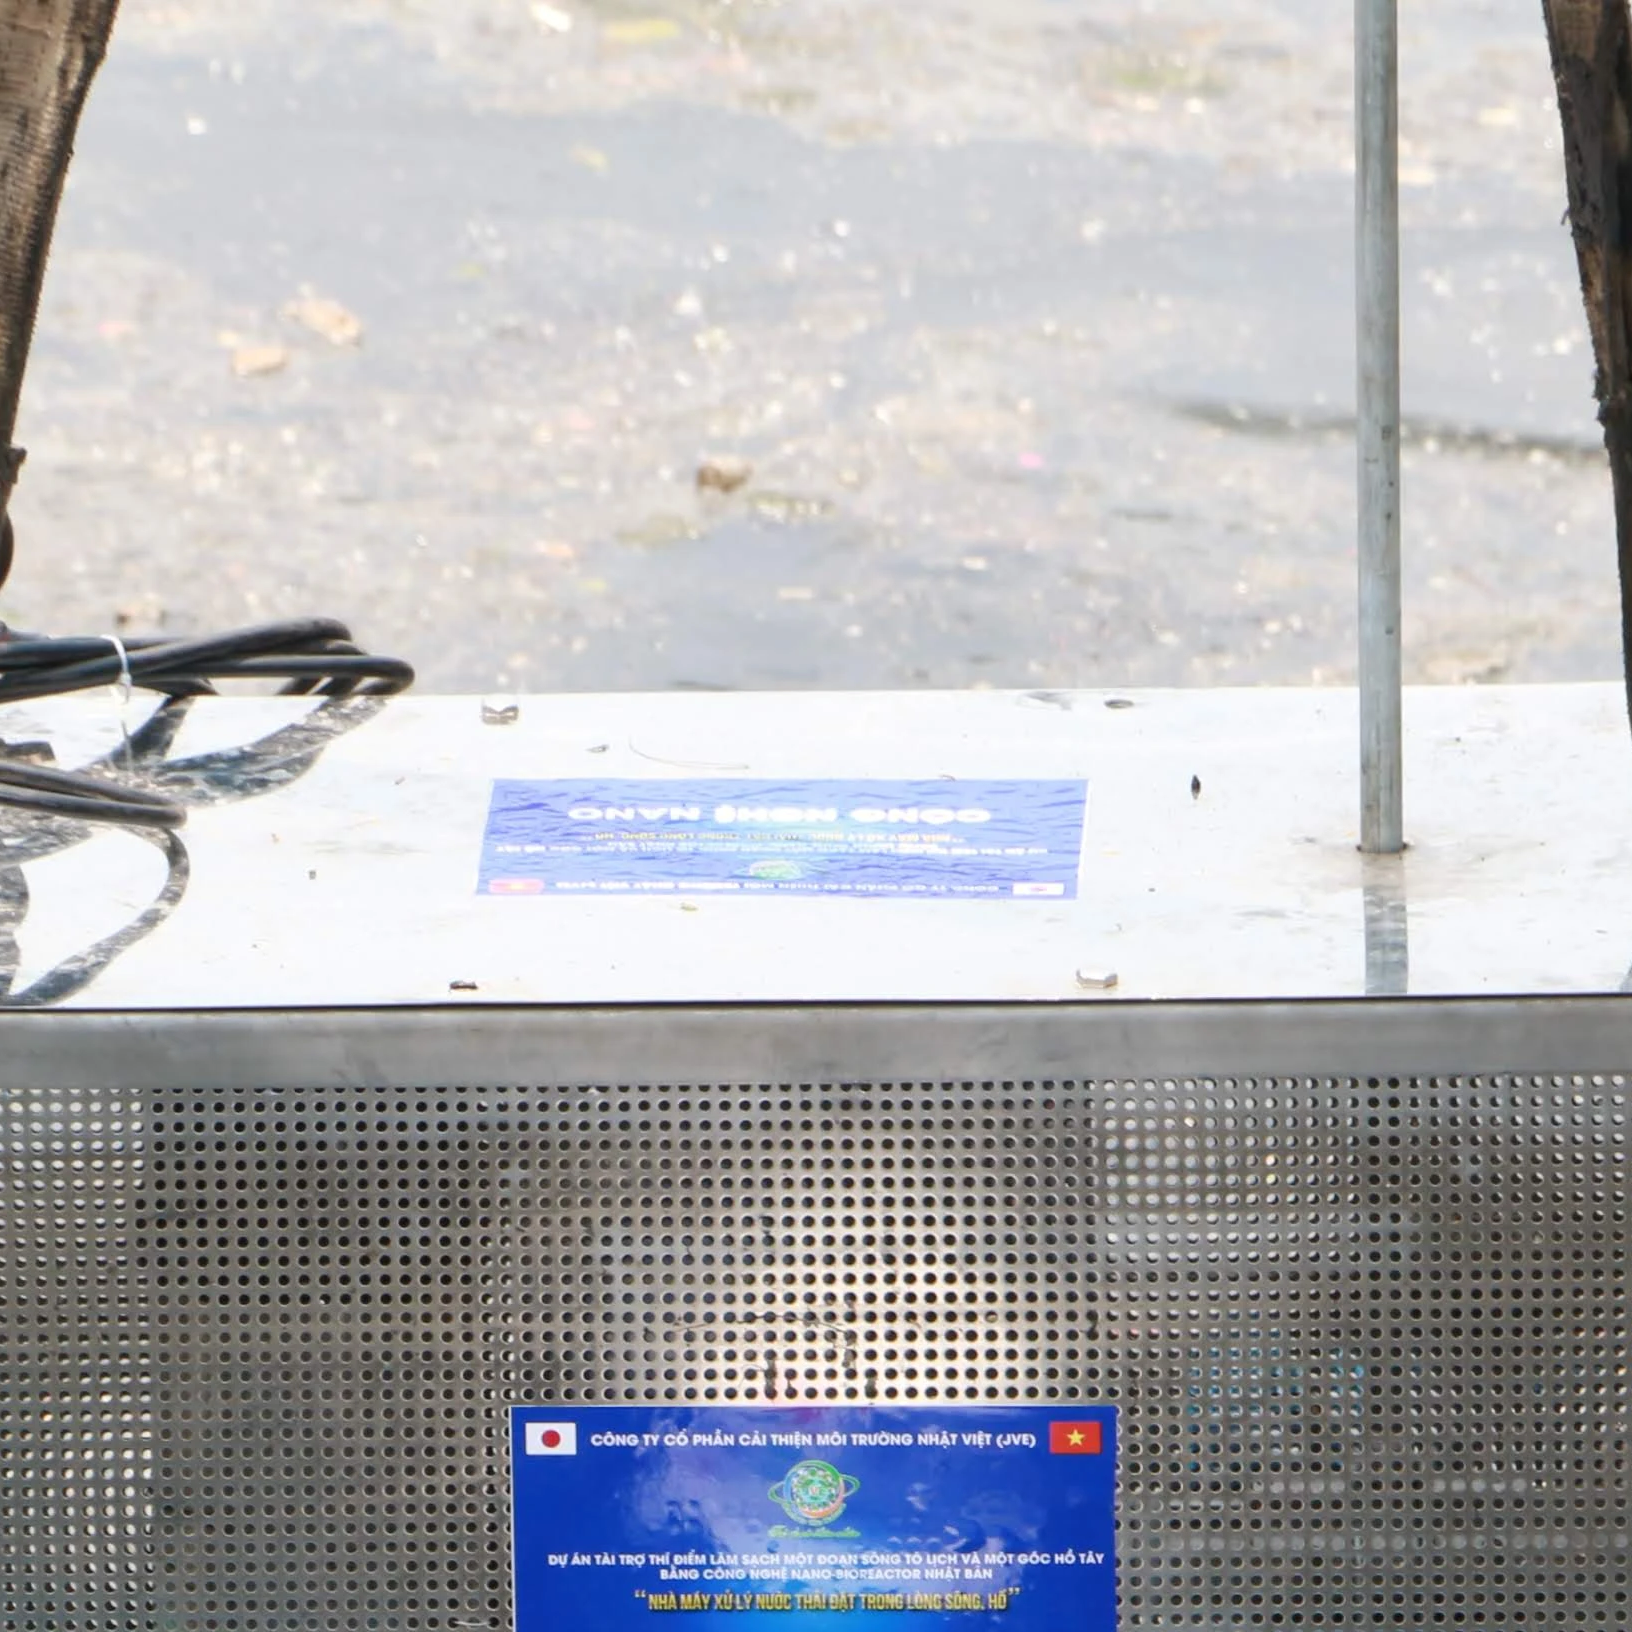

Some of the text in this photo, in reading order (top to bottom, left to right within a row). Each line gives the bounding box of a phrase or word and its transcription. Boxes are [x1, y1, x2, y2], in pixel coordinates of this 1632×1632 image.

[590, 1428, 1037, 1449] CÔNG TY CỔ PHẦN CẢI THIỆN MÔI TRƯỜNG NHẬT VIỆT (JVE)
[548, 1553, 568, 1568] DỰ
[571, 1551, 592, 1566] ÁN
[594, 1551, 616, 1566] TÀI
[619, 1553, 646, 1568] TRỢ
[649, 1551, 670, 1566] THÍ
[673, 1549, 708, 1566] ĐIỂM
[710, 1551, 738, 1566] LÀM
[742, 1554, 781, 1568] SẠCH
[926, 1553, 958, 1568] LỊCH
[962, 1550, 981, 1566] VÀ
[984, 1551, 1015, 1568] MỘT
[1018, 1550, 1051, 1566] GÓC
[1054, 1549, 1076, 1566] HỒ
[1079, 1550, 1105, 1566] TÂY
[660, 1565, 699, 1580] BẰNG
[703, 1567, 746, 1580] CÔNG
[750, 1567, 788, 1582] NGHỆ
[924, 1566, 961, 1581] NHẬT
[680, 1591, 710, 1611] MÁY
[713, 1591, 733, 1611] XỬ
[735, 1591, 752, 1611] LÝ
[859, 1593, 904, 1611] TRONG
